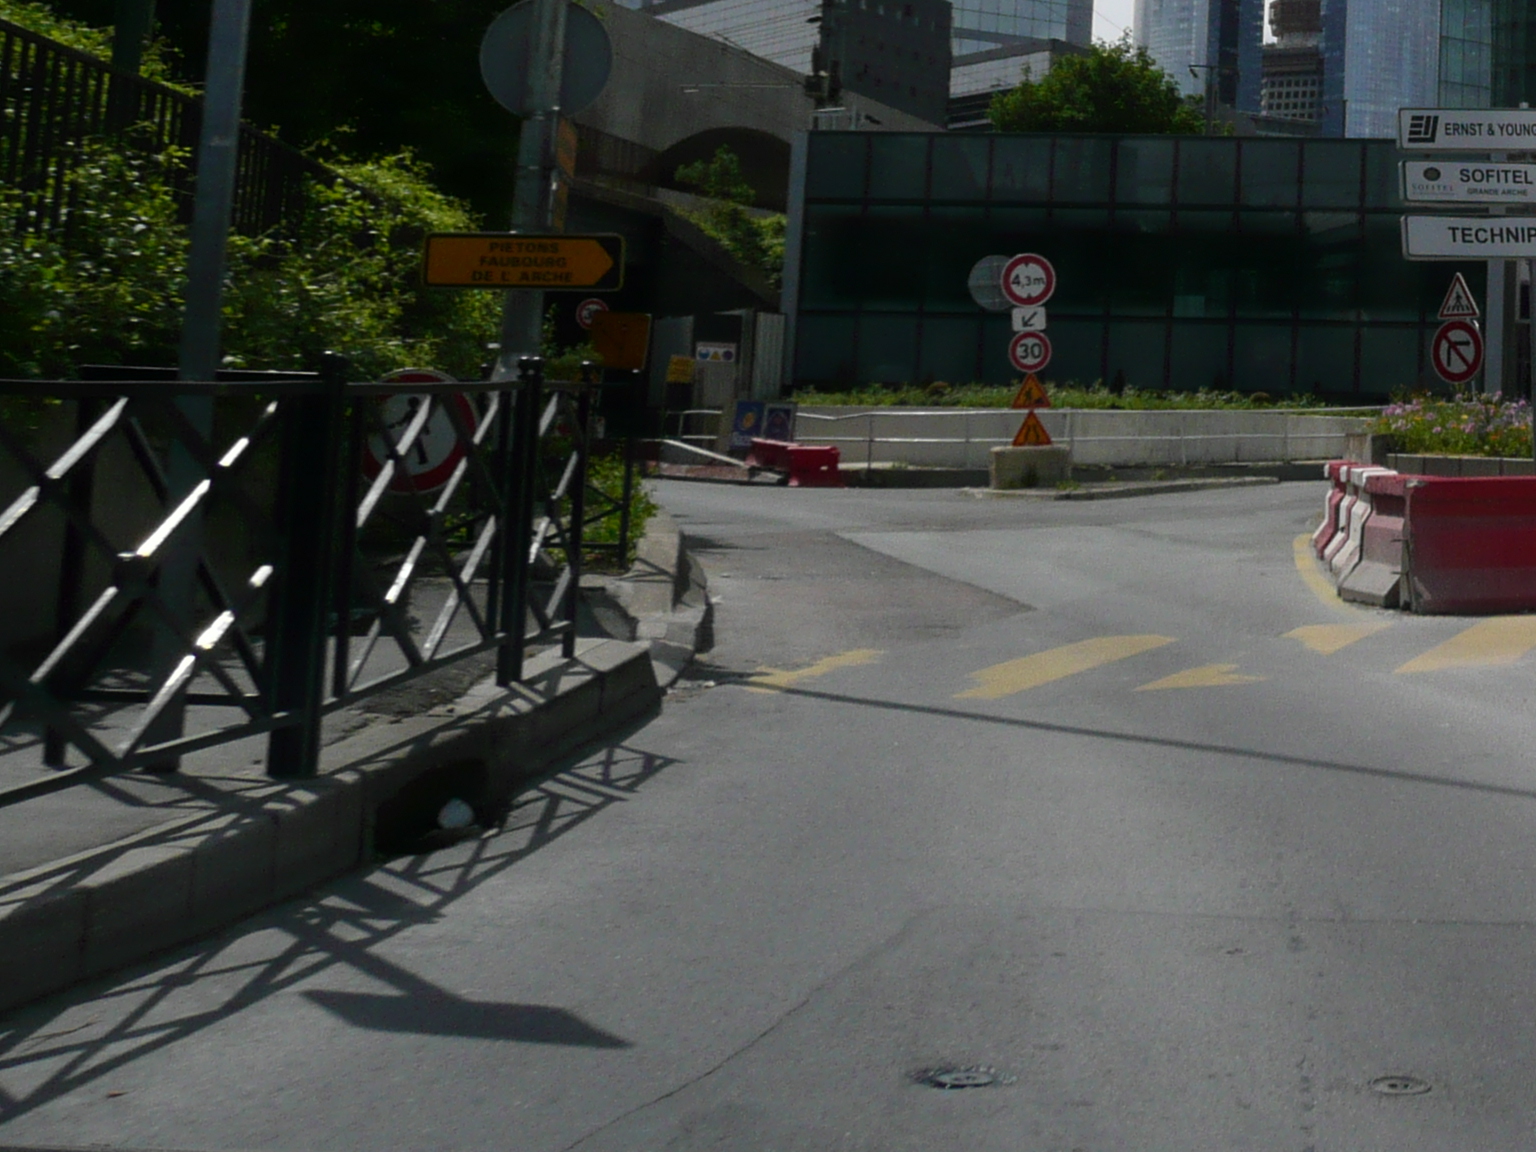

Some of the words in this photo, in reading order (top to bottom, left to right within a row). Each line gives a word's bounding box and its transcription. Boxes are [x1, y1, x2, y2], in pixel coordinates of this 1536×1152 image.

[1444, 123, 1484, 136] ERNST
[1487, 123, 1495, 136] &
[1459, 168, 1533, 185] SOFITEL
[1467, 188, 1499, 196] GRANDE
[1501, 189, 1528, 197] ARCHE
[489, 242, 559, 253] PIETONS
[479, 256, 567, 268] FAUBOURG
[472, 271, 493, 282] DE
[519, 271, 573, 283] ARCHE
[1019, 343, 1044, 360] 30
